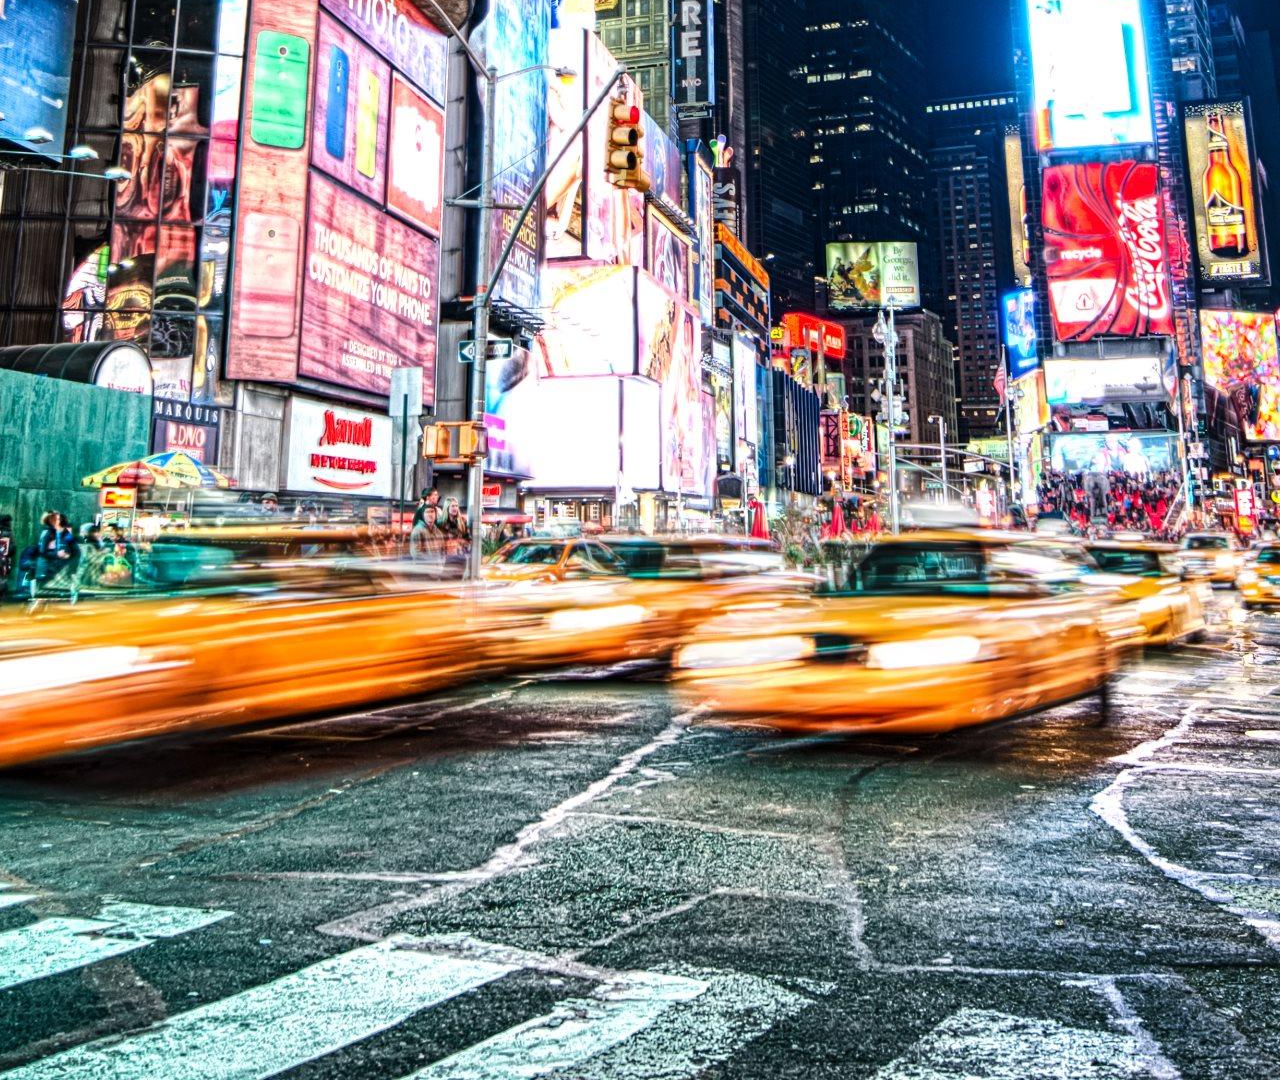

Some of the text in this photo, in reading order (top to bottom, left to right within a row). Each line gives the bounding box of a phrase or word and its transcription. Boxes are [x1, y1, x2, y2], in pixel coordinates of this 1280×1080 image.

[681, 78, 702, 88] NYC
[313, 222, 379, 275] THOUSANDS
[309, 255, 370, 302] CUSTOMIZE
[370, 280, 399, 314] YOUR
[154, 400, 219, 423] MARQUIS
